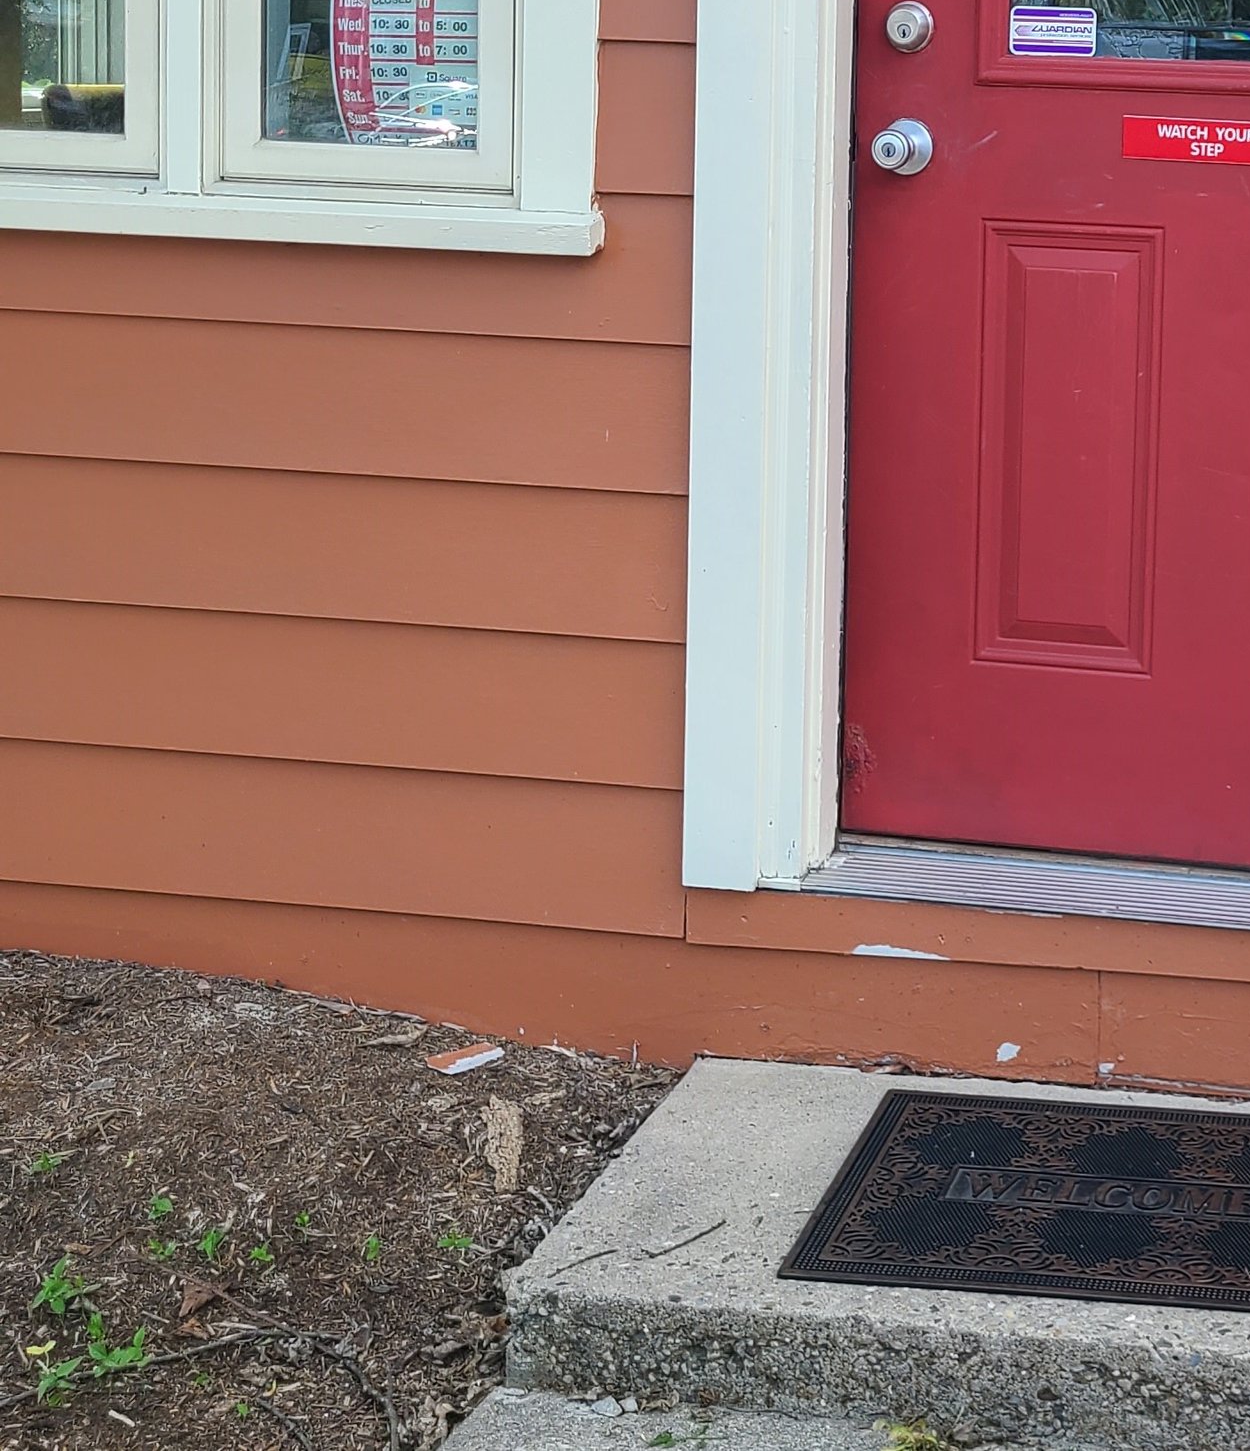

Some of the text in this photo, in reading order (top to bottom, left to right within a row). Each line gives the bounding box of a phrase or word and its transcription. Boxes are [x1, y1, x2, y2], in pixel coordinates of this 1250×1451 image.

[337, 17, 365, 31] Wed.
[418, 17, 431, 32] to
[1031, 24, 1093, 34] GUARDIAN
[338, 41, 367, 55] Thur.
[418, 43, 431, 57] to
[339, 65, 359, 80] Fri.
[438, 73, 467, 83] Square
[342, 88, 366, 103] Sat.
[346, 111, 372, 125] Sun.
[1157, 123, 1208, 140] WATCH
[1190, 141, 1224, 157] STEP
